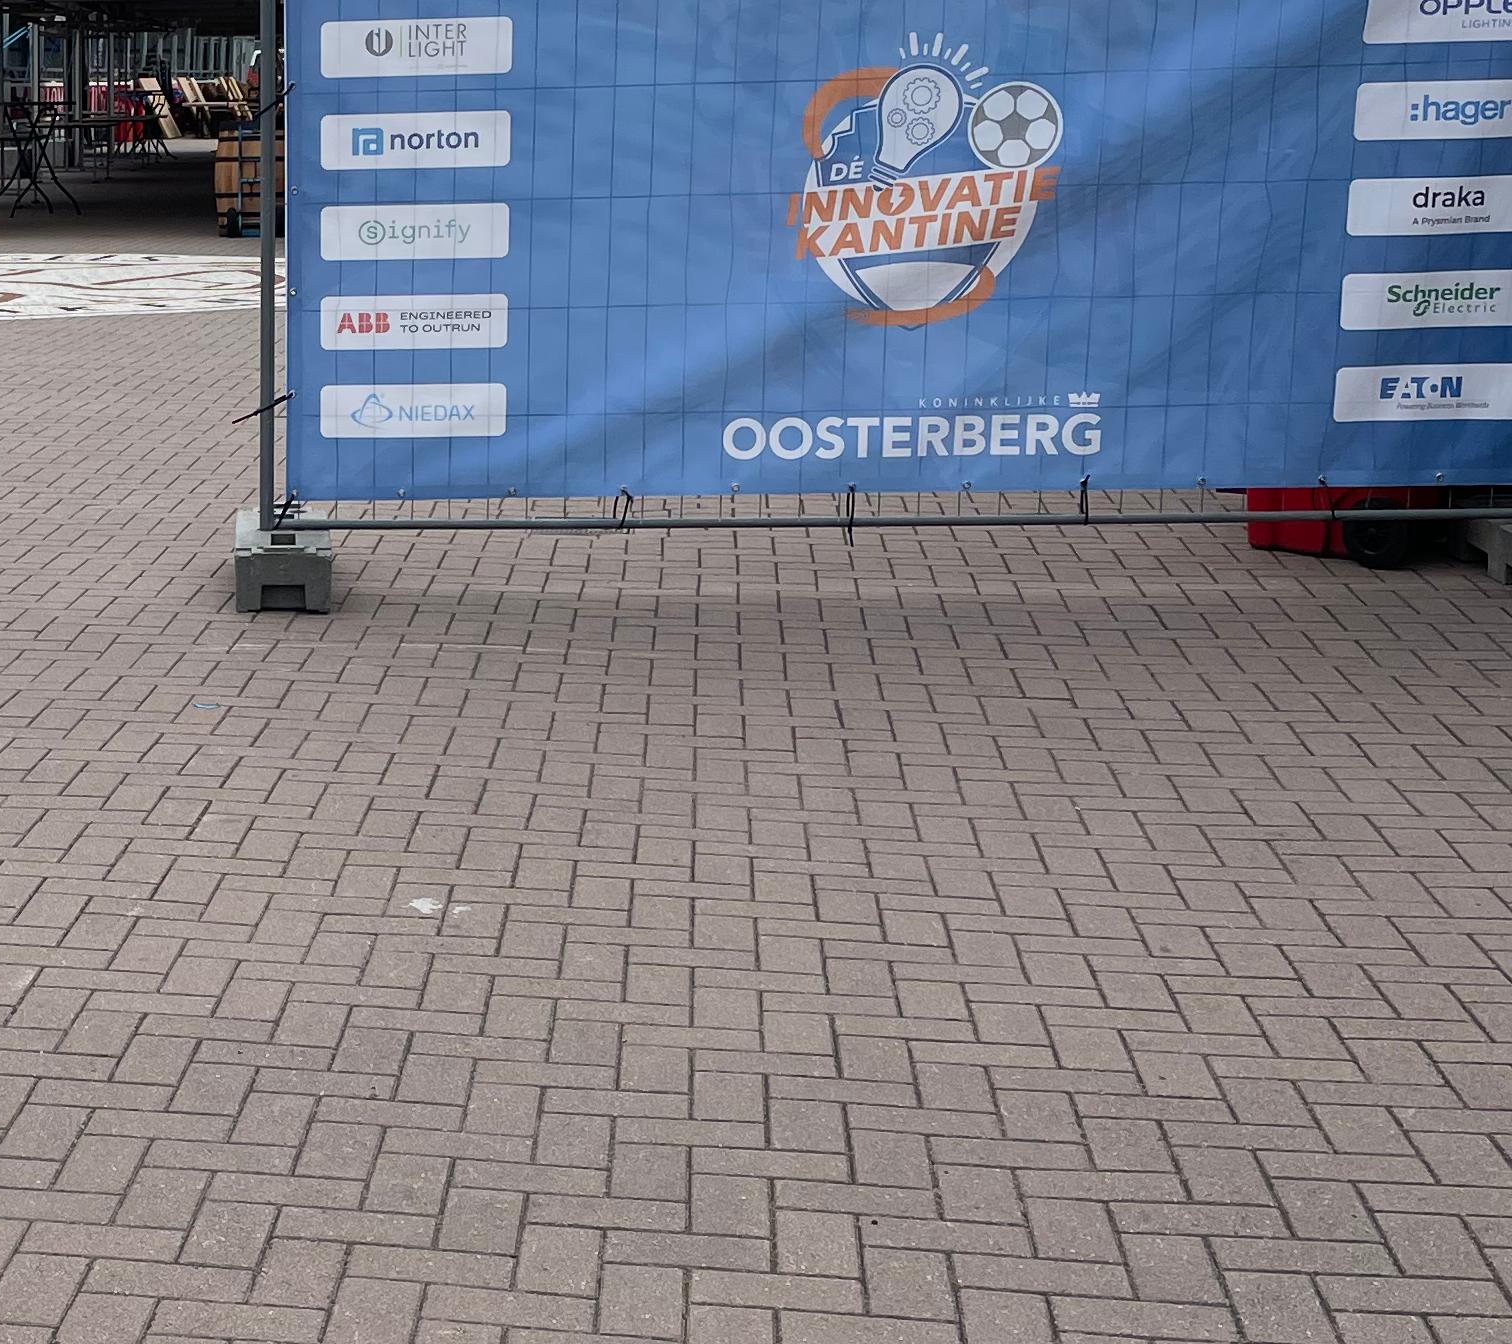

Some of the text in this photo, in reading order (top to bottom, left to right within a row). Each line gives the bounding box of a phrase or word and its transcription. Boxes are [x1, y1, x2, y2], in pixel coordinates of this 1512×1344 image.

[408, 23, 467, 40] INTER
[1461, 18, 1512, 29] LIGHTIN
[408, 40, 467, 58] LIGHT
[390, 129, 479, 150] norton
[829, 155, 865, 182] DÉ
[784, 165, 1061, 227] INNOVATIE
[1412, 185, 1485, 208] draka
[358, 219, 472, 245] signify
[794, 206, 1023, 260] KANTINE
[1387, 282, 1500, 303] Schneider
[400, 311, 492, 321] ENGINEERED
[1433, 303, 1496, 314] Electric
[337, 312, 390, 334] ABB
[400, 323, 480, 333] TO OUTRUN
[1380, 376, 1463, 399] EATON
[919, 395, 1061, 409] KONINKLIJKE
[399, 404, 476, 422] NIEDAX
[722, 412, 1102, 461] OOSTERBERG
